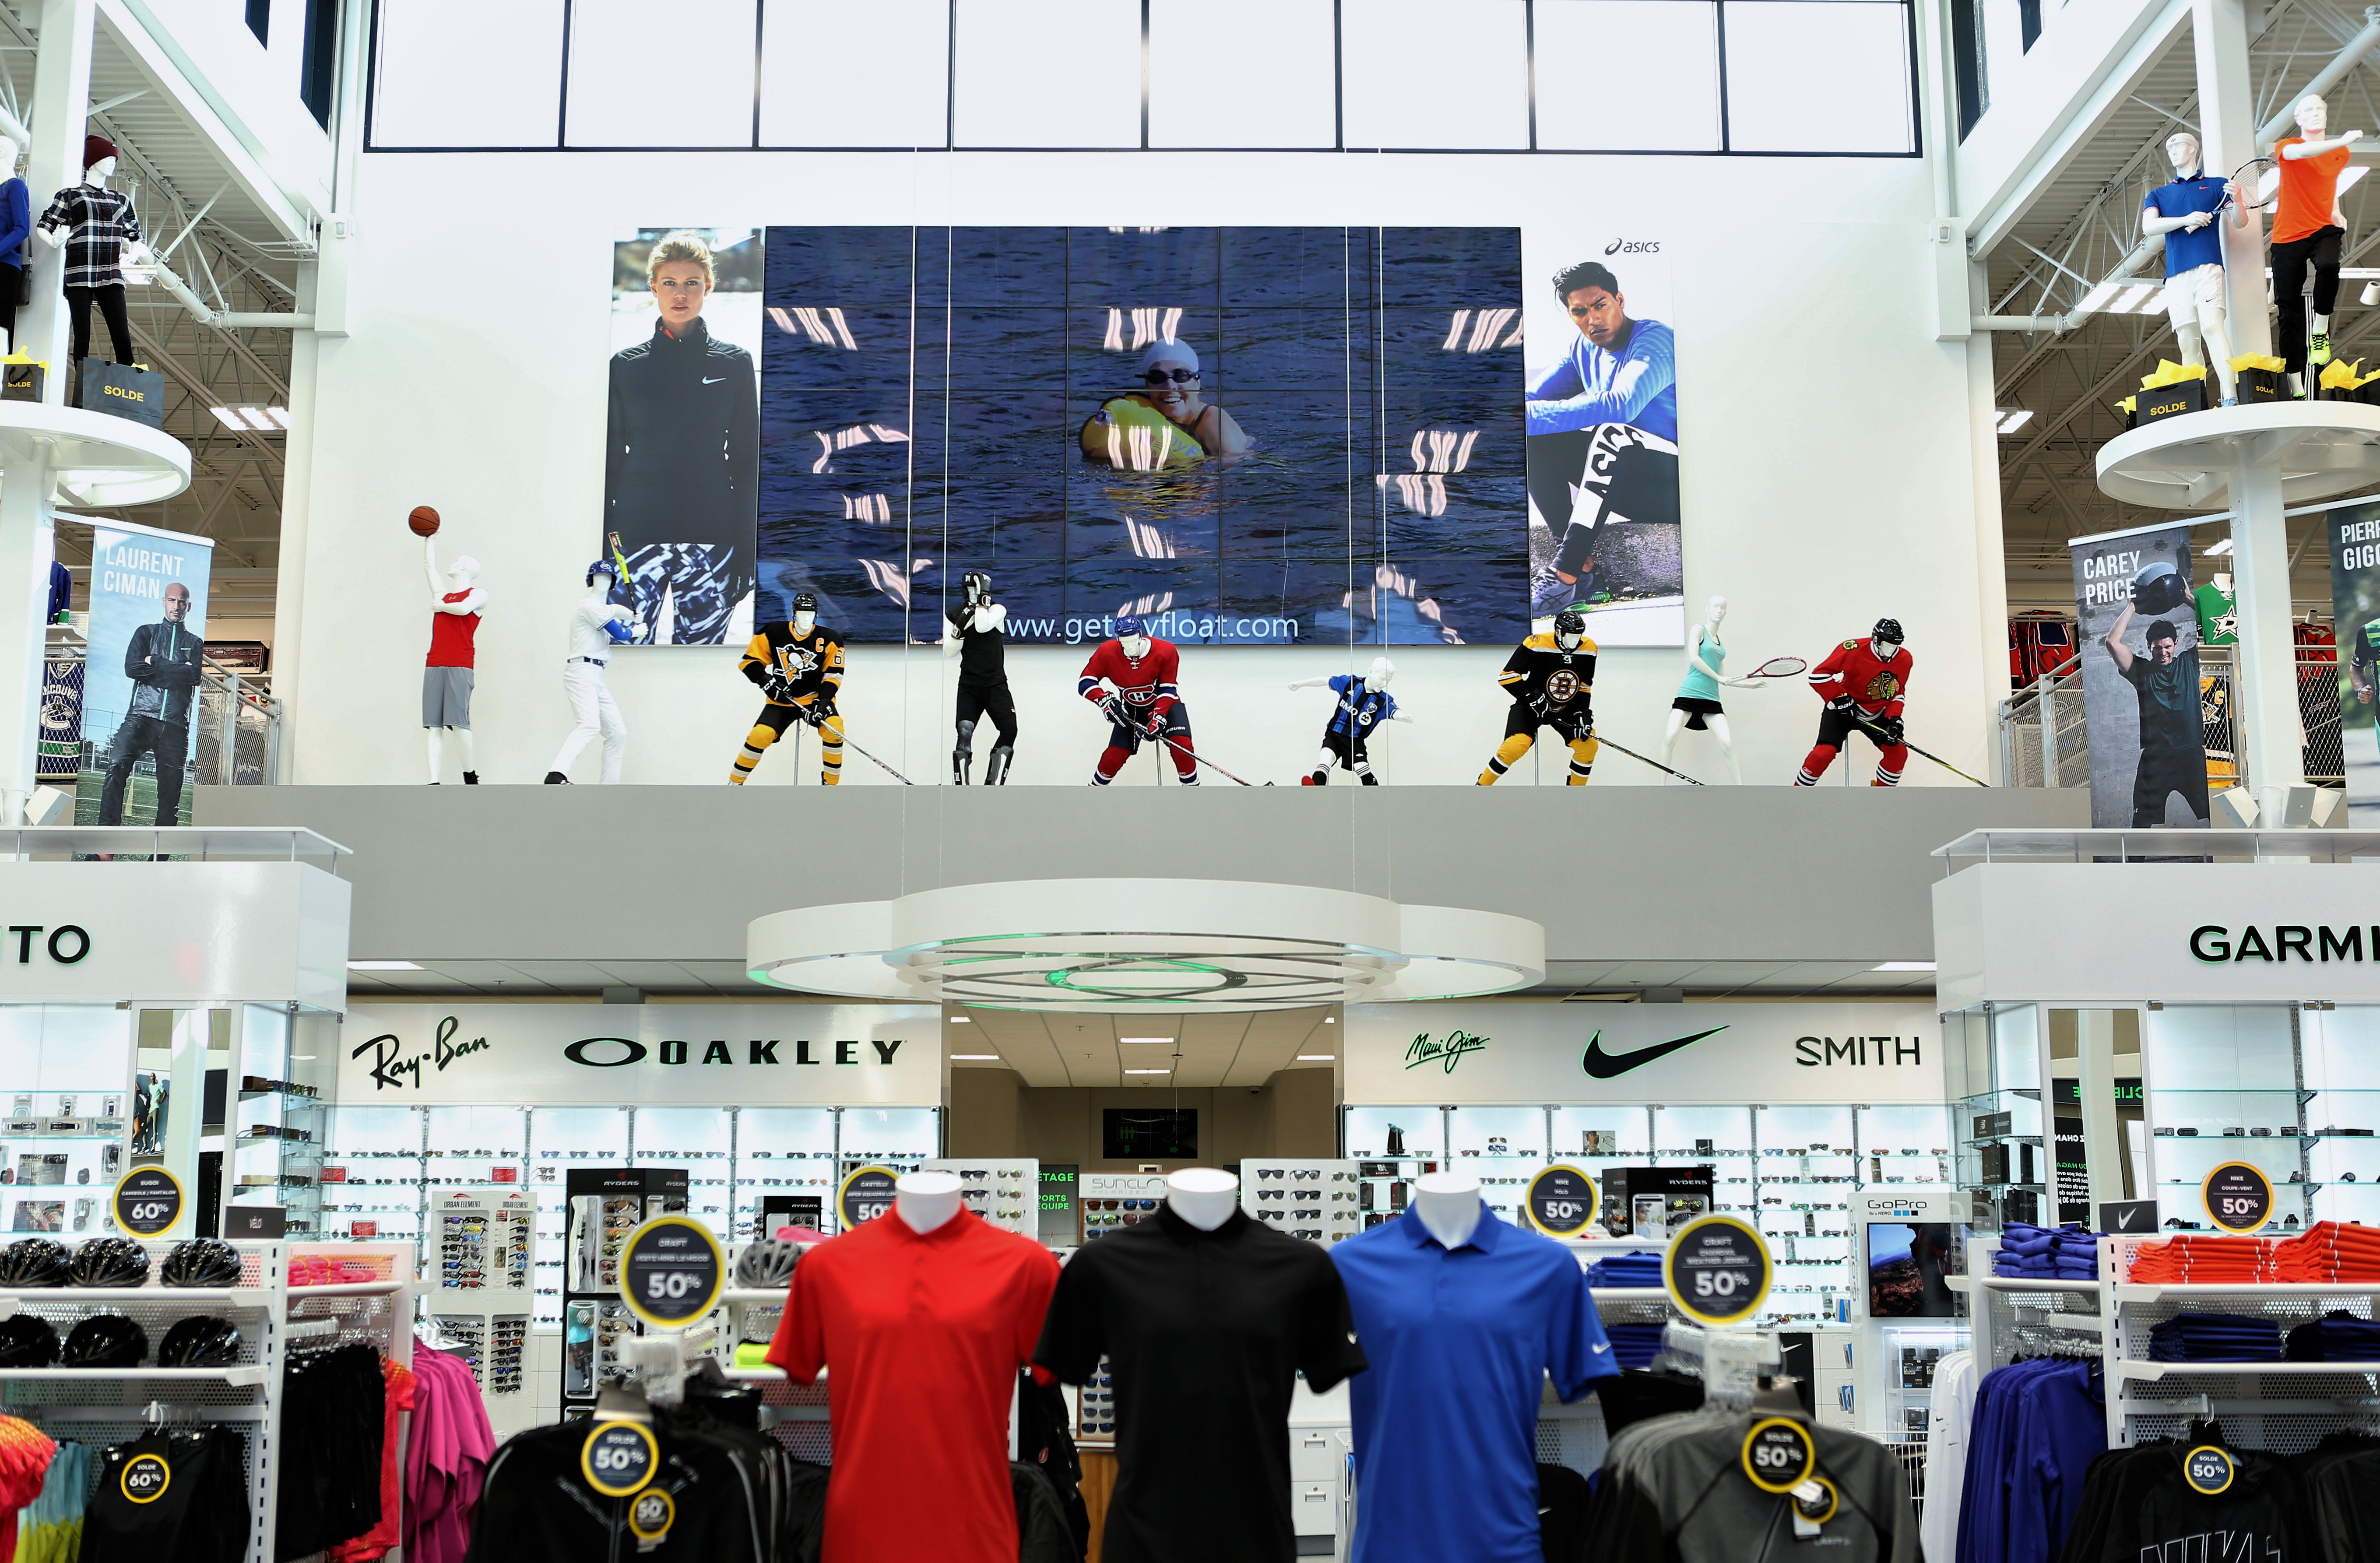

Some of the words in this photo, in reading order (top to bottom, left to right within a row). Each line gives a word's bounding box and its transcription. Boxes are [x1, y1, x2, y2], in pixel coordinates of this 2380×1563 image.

[1623, 242, 1660, 253] asics
[104, 385, 144, 402] SOLDE
[2150, 401, 2187, 416] SOLDE
[105, 545, 184, 577] LAURENT
[2084, 550, 2141, 580] CAREY
[103, 570, 161, 600] CIMAN
[2085, 577, 2137, 605] PRICE
[1005, 611, 1298, 645] ww.getyfloat.com
[816, 637, 824, 653] C
[1339, 699, 1358, 716] BMO
[0, 924, 91, 965] TO
[659, 1040, 903, 1065] OAKLEY
[1405, 1032, 1443, 1061] Maui
[1795, 1036, 1921, 1067] SMITH
[132, 1202, 169, 1220] 60%
[1545, 1201, 1582, 1219] 50%
[1867, 1200, 1927, 1209] GoPro
[2222, 1198, 2258, 1215] 50%
[647, 1271, 703, 1299] 50%
[1694, 1270, 1750, 1297] 50%
[595, 1446, 647, 1470] 50%
[1755, 1445, 1803, 1468] 50%
[129, 1472, 161, 1488] 60%
[2193, 1464, 2225, 1478] 50%
